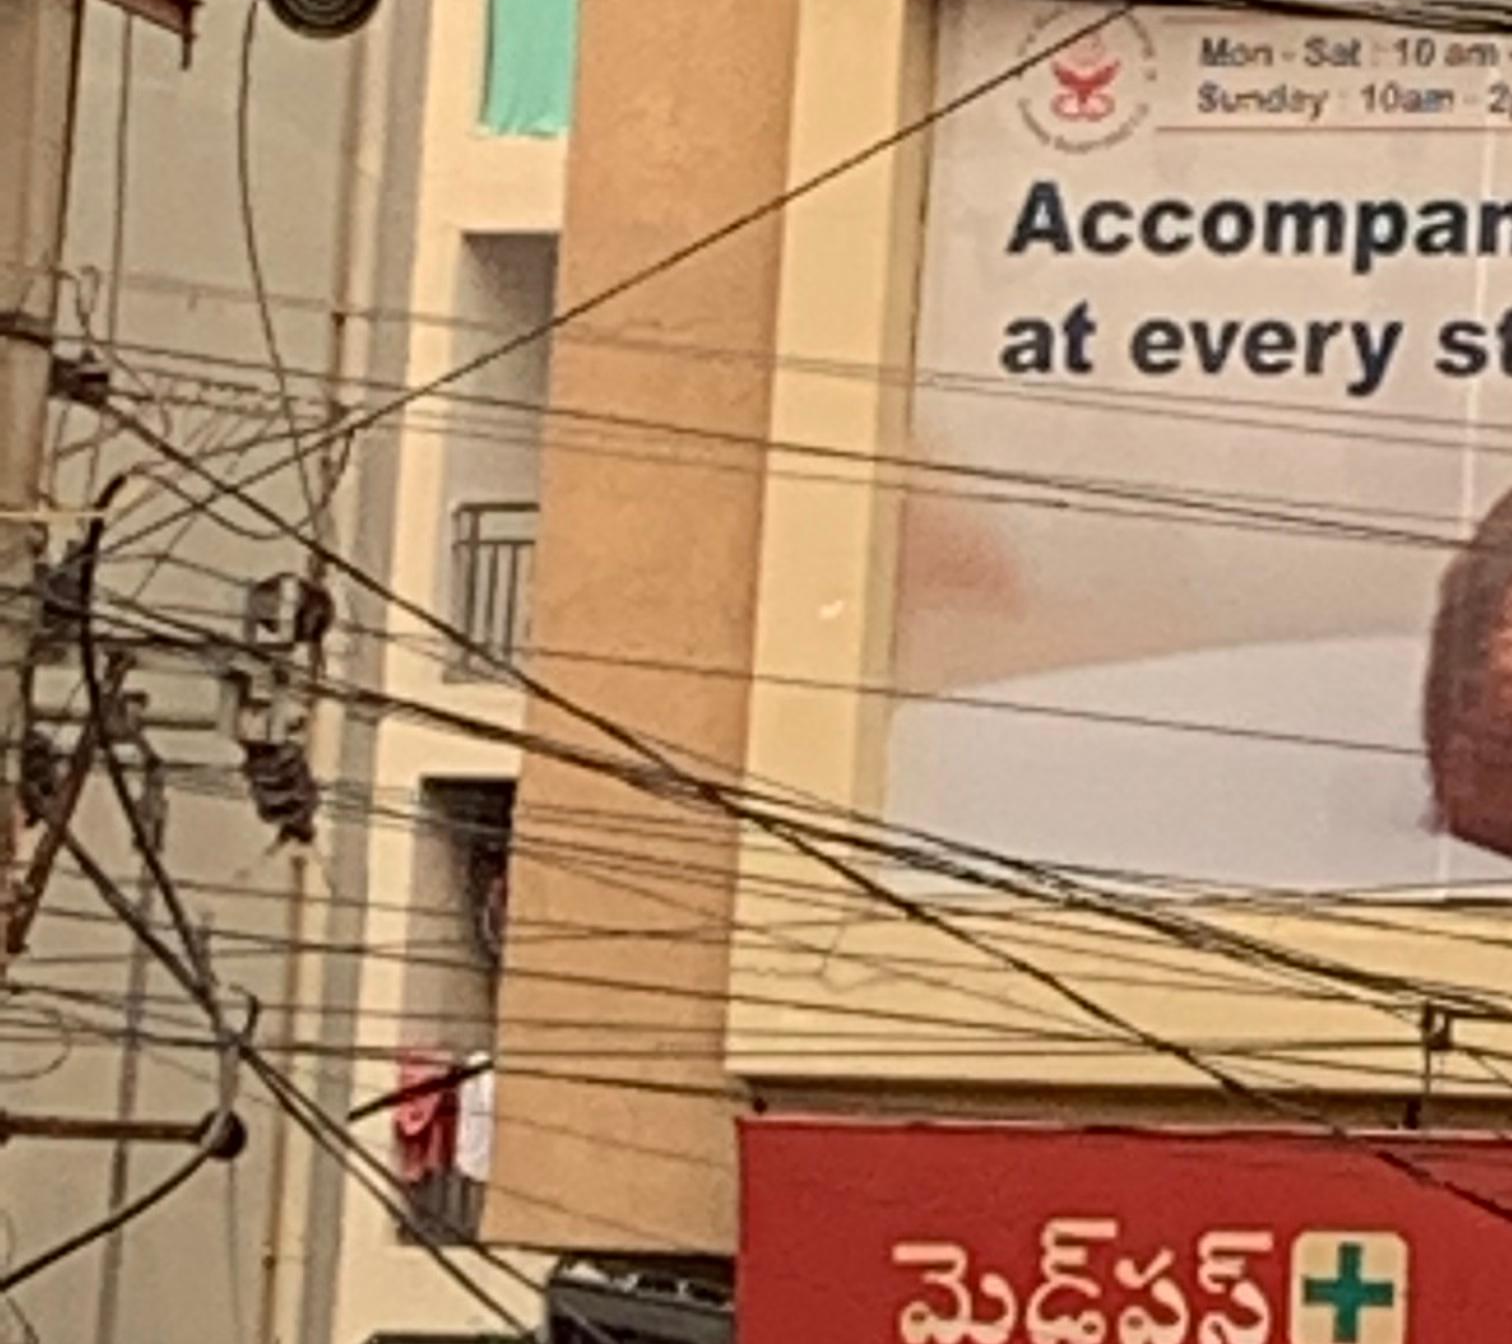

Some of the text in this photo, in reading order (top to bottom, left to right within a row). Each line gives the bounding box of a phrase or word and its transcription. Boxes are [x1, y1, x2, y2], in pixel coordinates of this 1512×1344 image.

[1200, 36, 1274, 68] Mon
[1303, 35, 1362, 68] Sat
[1394, 36, 1436, 68] 10
[1444, 41, 1499, 68] am
[1197, 80, 1329, 122] Sunday
[1359, 80, 1455, 113] 10am
[999, 299, 1098, 376] at
[1130, 315, 1403, 396] every
